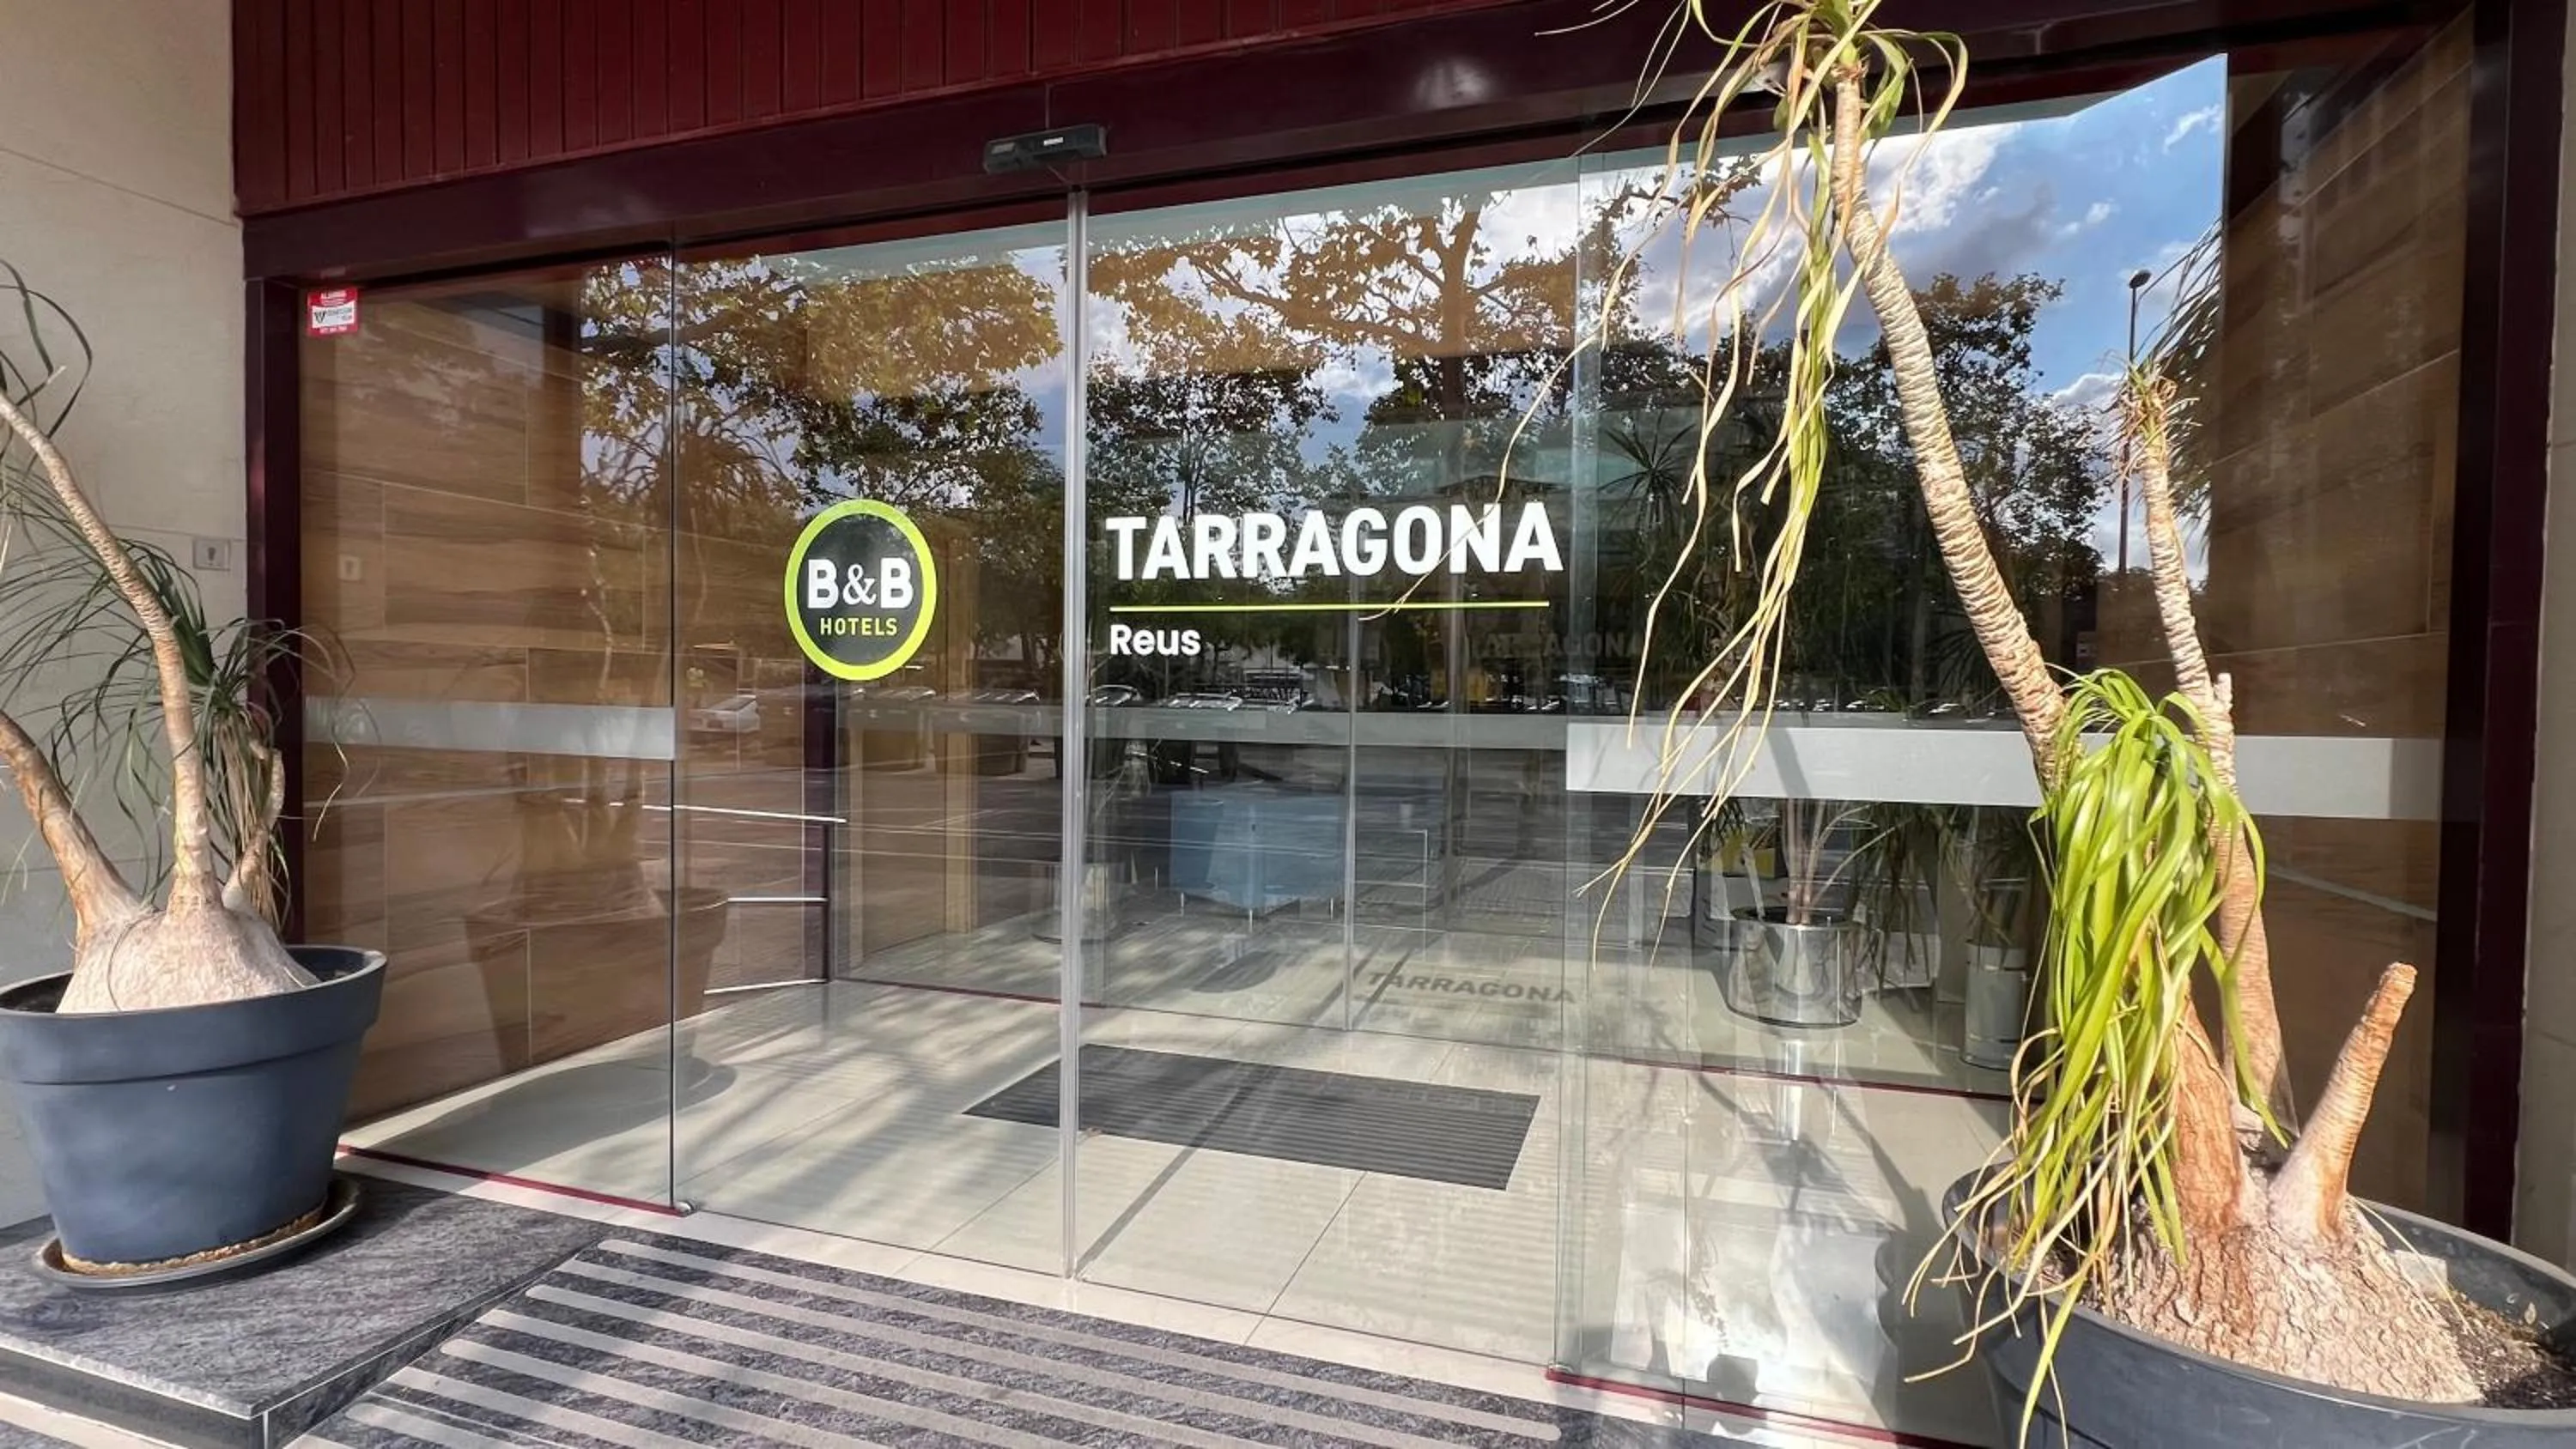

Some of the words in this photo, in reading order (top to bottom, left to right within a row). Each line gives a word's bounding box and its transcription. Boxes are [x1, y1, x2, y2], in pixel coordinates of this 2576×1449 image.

[1106, 502, 1563, 579] TARRAGONA
[807, 558, 914, 609] B&B
[820, 617, 898, 635] HOTELS
[1109, 624, 1201, 656] Reus
